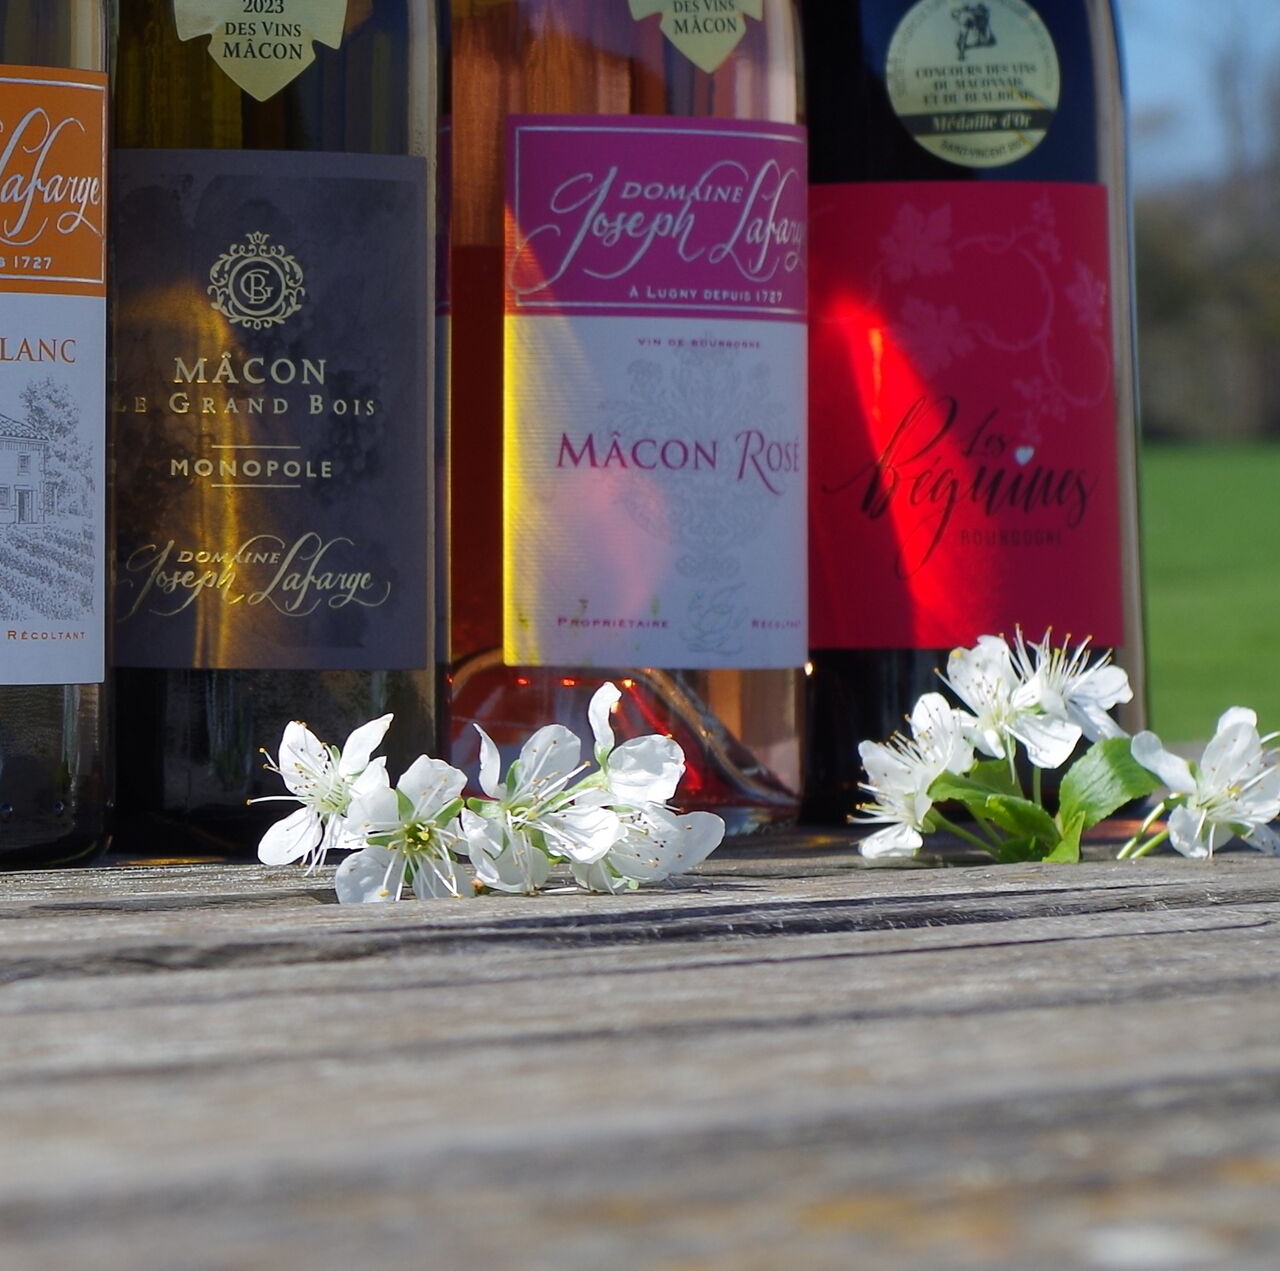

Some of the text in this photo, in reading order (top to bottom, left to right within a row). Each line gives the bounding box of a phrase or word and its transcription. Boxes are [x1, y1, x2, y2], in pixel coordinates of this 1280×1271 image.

[673, 0, 699, 13] DES
[224, 21, 302, 37] DES VINS
[674, 15, 737, 35] MÂCON
[223, 38, 302, 60] MÂCON
[933, 112, 997, 131] Médaille
[620, 181, 743, 203] DOMAINE
[509, 158, 806, 295] Joseph Lafarg
[15, 255, 53, 269] 1727
[646, 286, 697, 300] LUGNY
[704, 289, 751, 302] DEPUIS
[637, 337, 661, 346] VIN
[668, 338, 684, 347] DE
[173, 351, 327, 385] MÂCON
[169, 392, 289, 414] GRAND
[310, 395, 375, 416] BOIS
[556, 431, 718, 471] MÂCON
[170, 458, 333, 478] MONOPOLE
[177, 550, 281, 564] DOMAINE
[116, 532, 391, 623] Joseph Lafarge
[557, 616, 669, 629] PROPRIÉTAIRE
[7, 628, 87, 640] RÉCOLTANT
